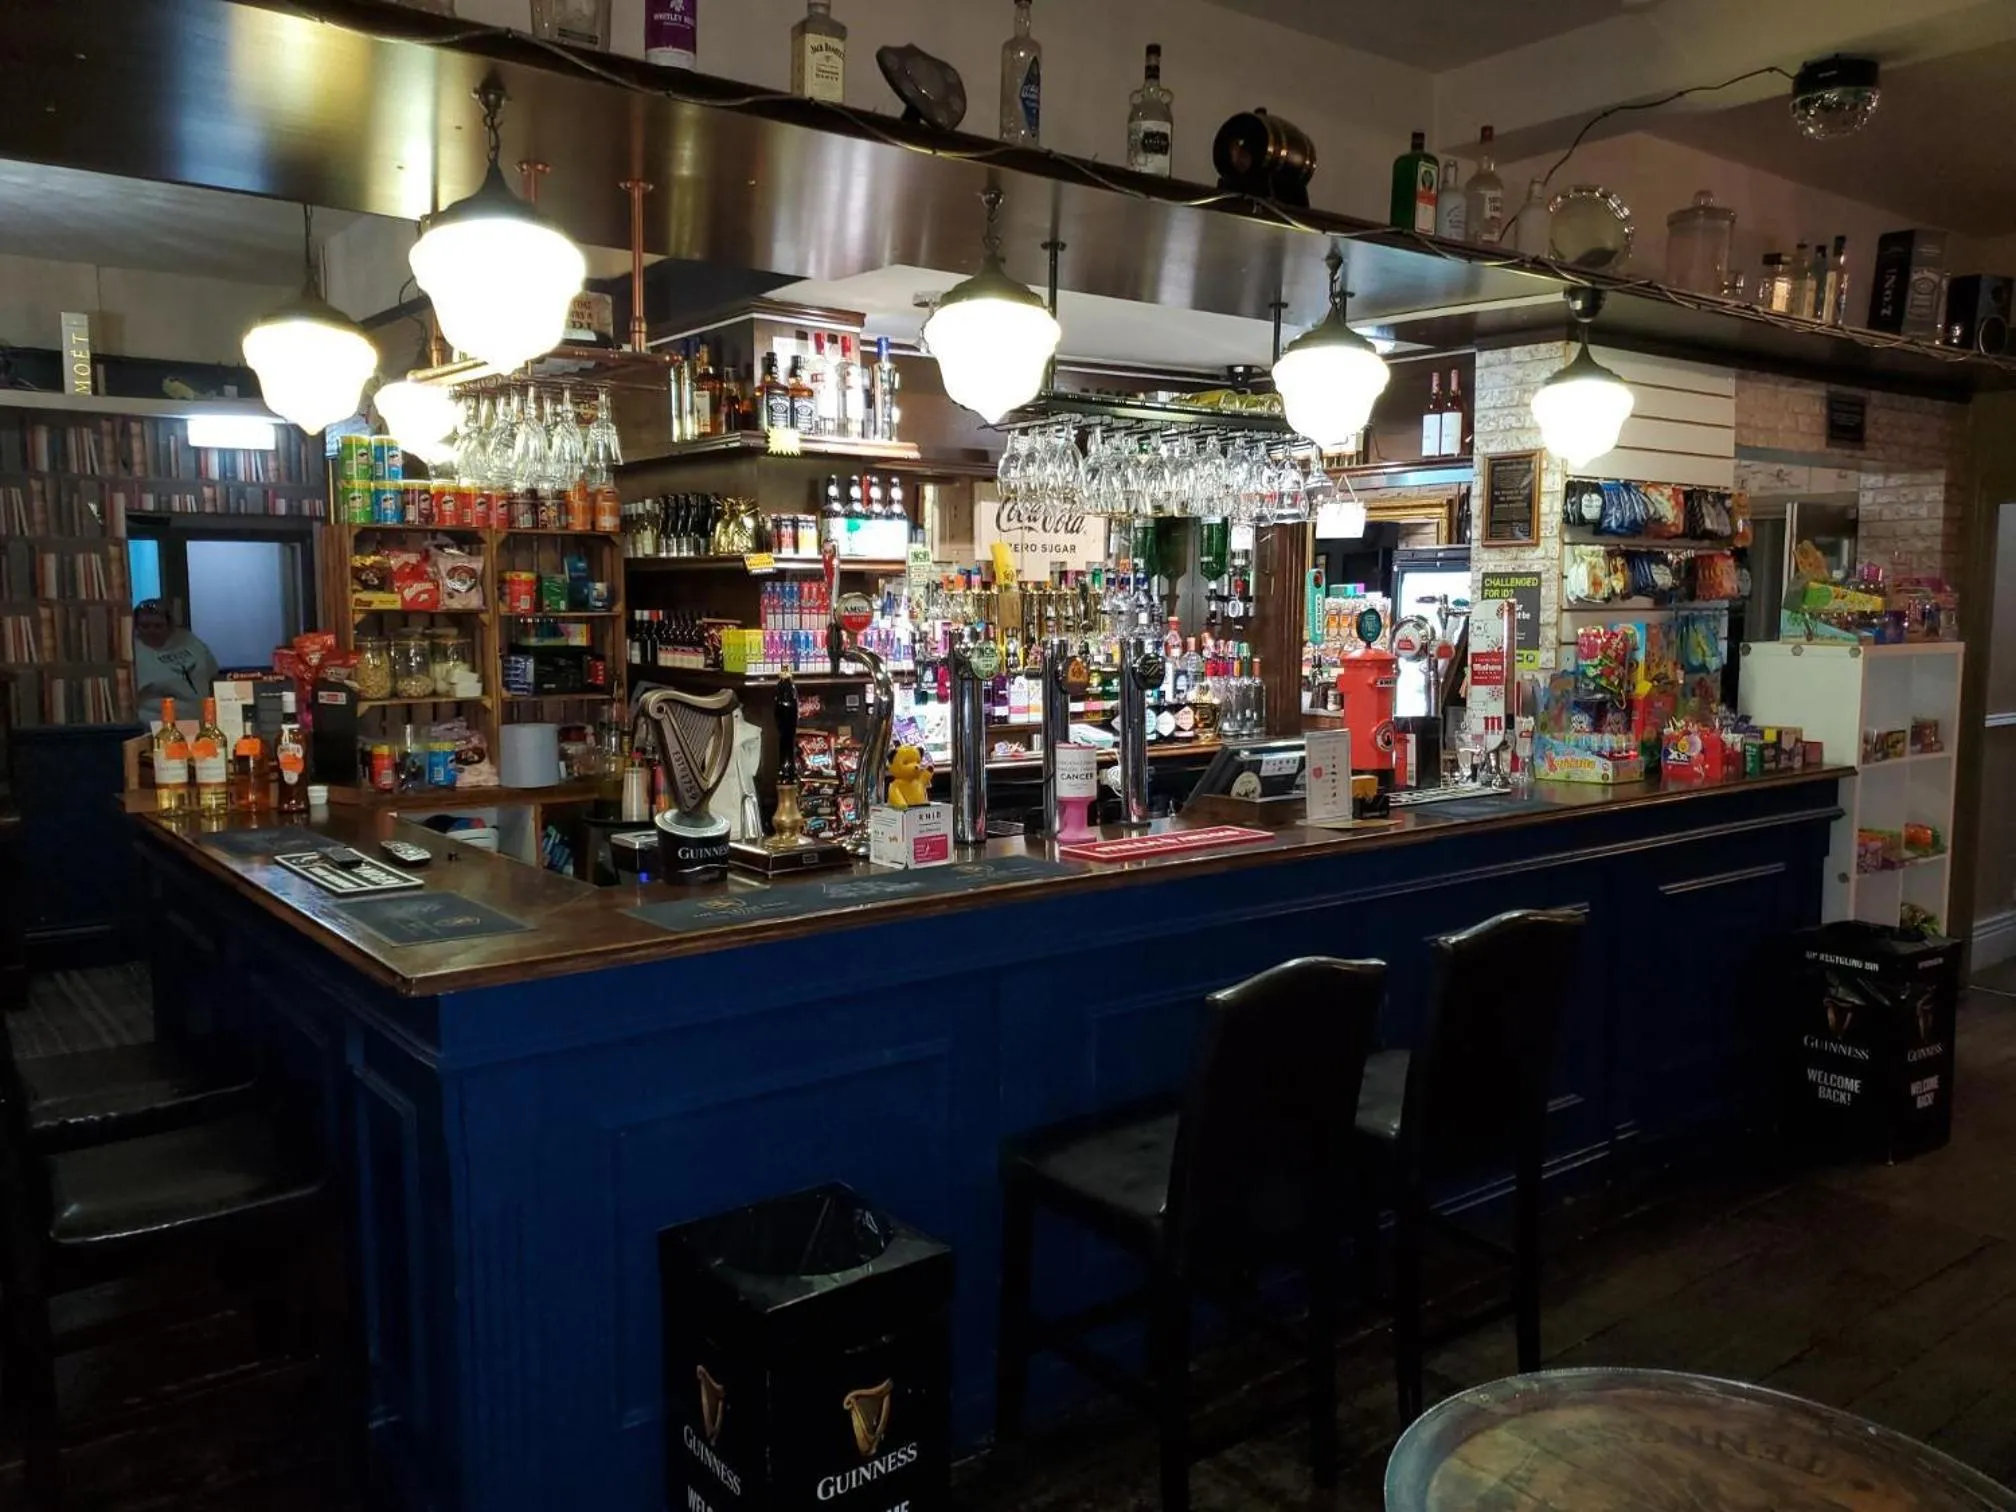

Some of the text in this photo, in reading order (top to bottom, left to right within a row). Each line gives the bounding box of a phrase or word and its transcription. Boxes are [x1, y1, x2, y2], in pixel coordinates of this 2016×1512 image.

[1041, 543, 1077, 554] SUGAR
[1484, 576, 1539, 587] CHALLENGED
[1484, 588, 1514, 599] FOR ID?
[1803, 1034, 1870, 1061] GUINNESS
[1807, 1067, 1862, 1094] WELCOME
[1817, 1085, 1852, 1106] BACK!
[683, 1424, 742, 1497] GUINNESS
[815, 1441, 919, 1502] GUINNESS
